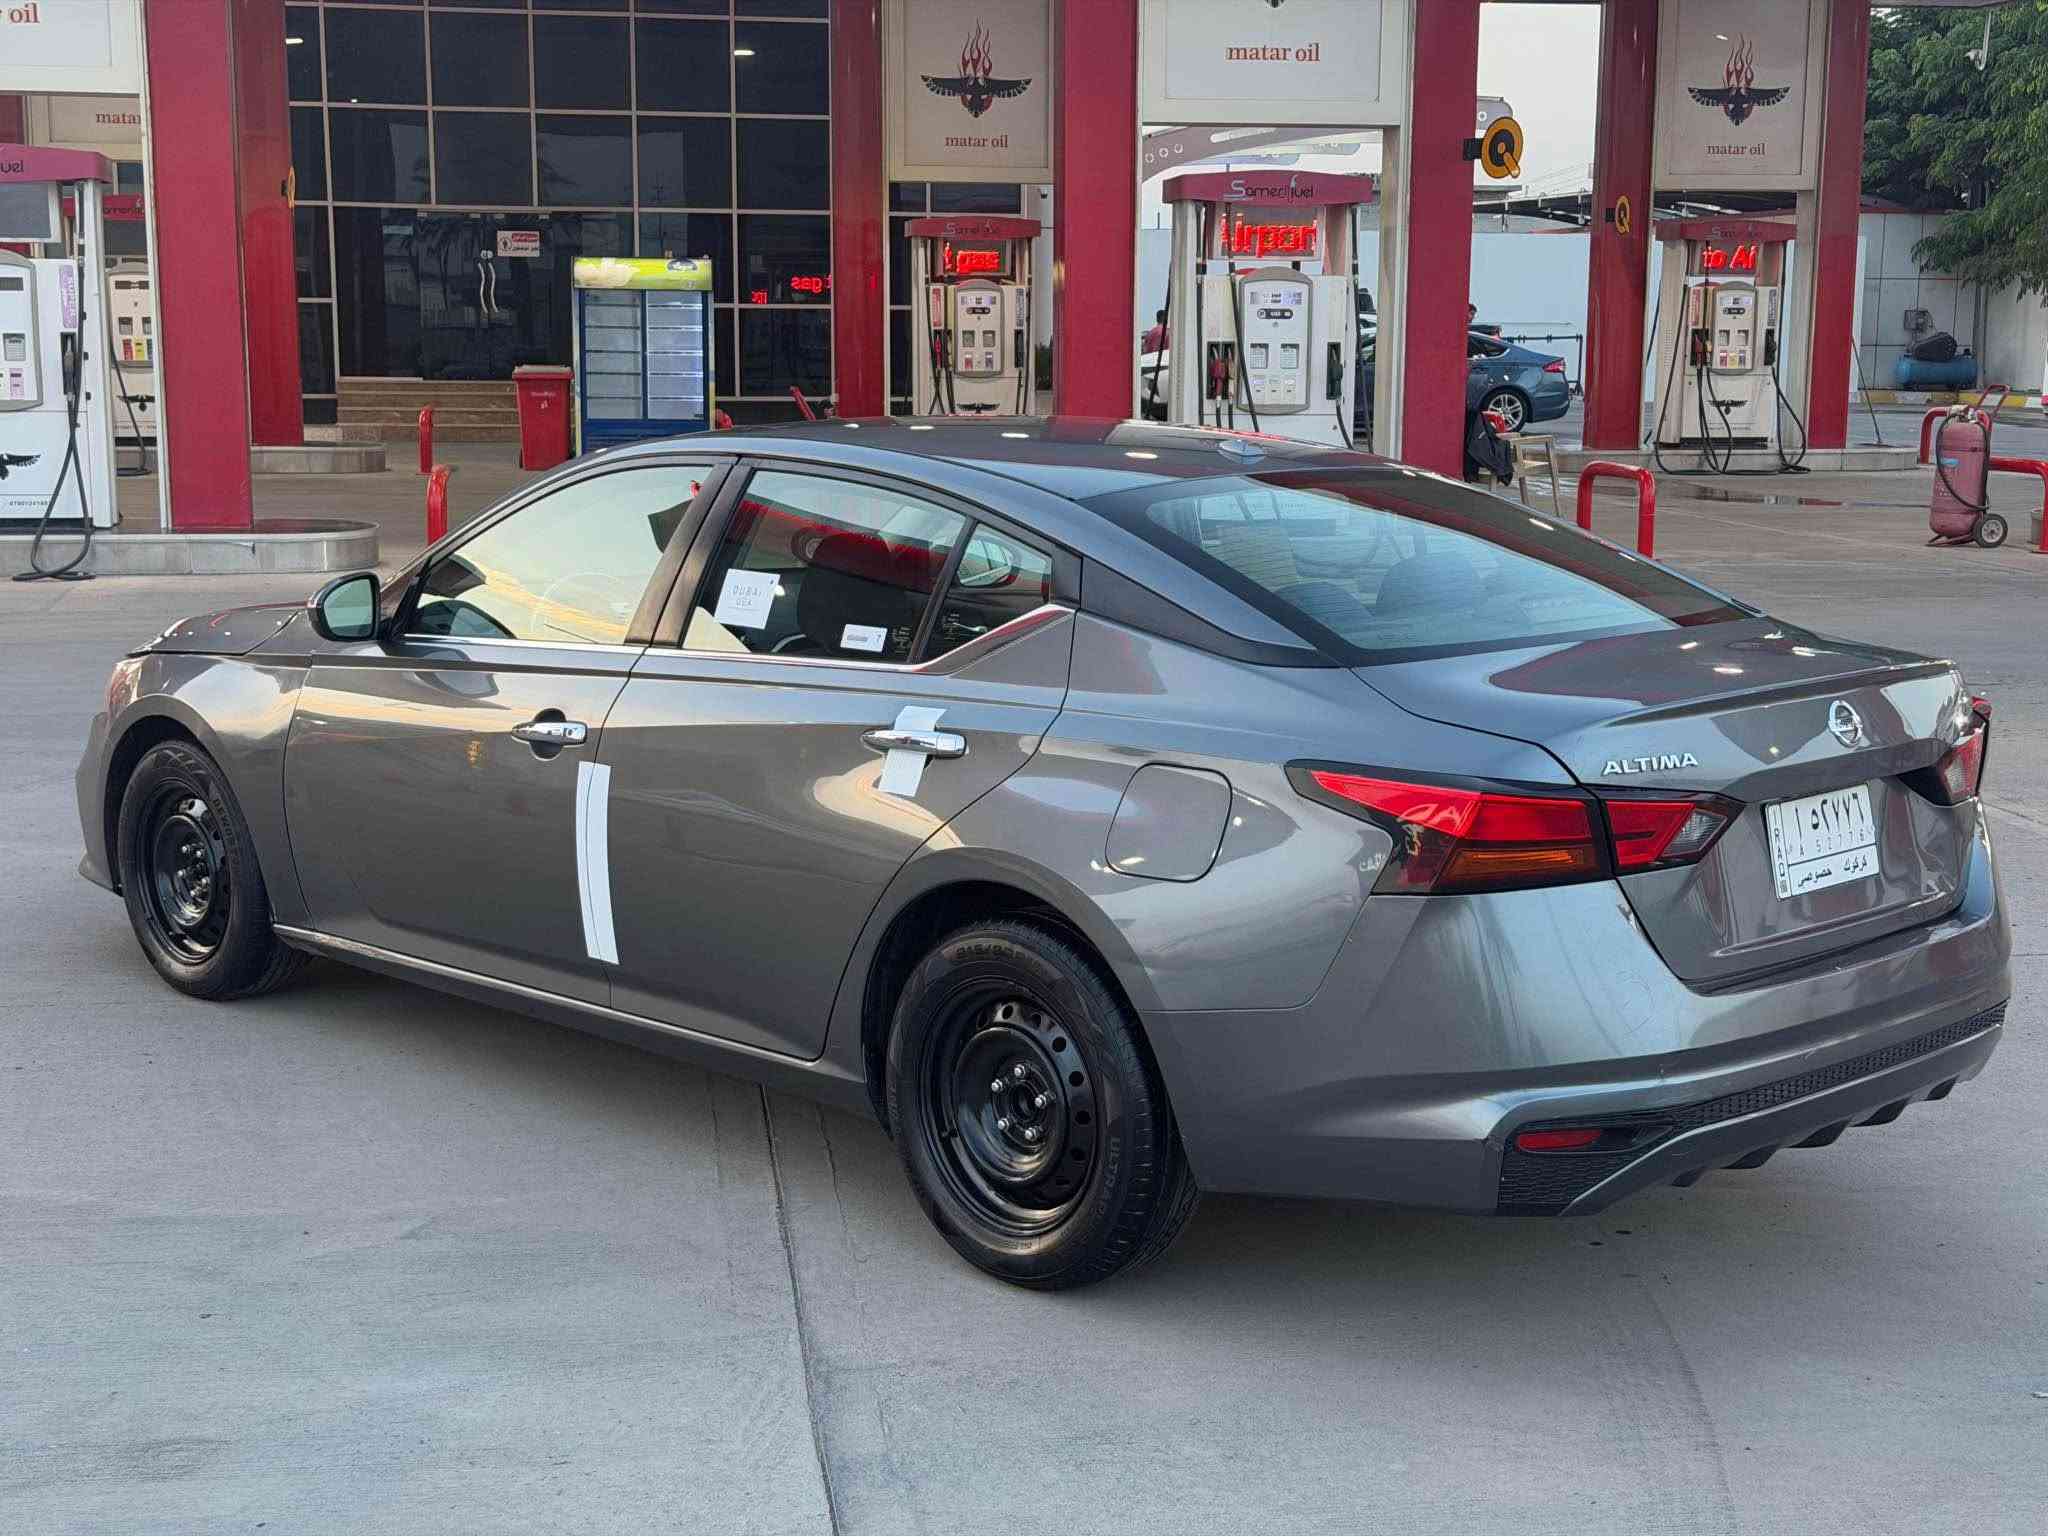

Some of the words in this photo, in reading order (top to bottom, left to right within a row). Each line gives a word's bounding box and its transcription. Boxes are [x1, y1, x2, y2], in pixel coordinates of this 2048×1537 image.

[10, 3, 40, 24] oil
[1227, 44, 1292, 61] matar
[1295, 43, 1320, 62] oil
[944, 136, 989, 148] matar
[991, 135, 1009, 148] oil
[1706, 144, 1747, 155] matar
[1749, 143, 1766, 156] oil
[0, 159, 24, 174] uel
[1601, 752, 1699, 776] ALTIMA
